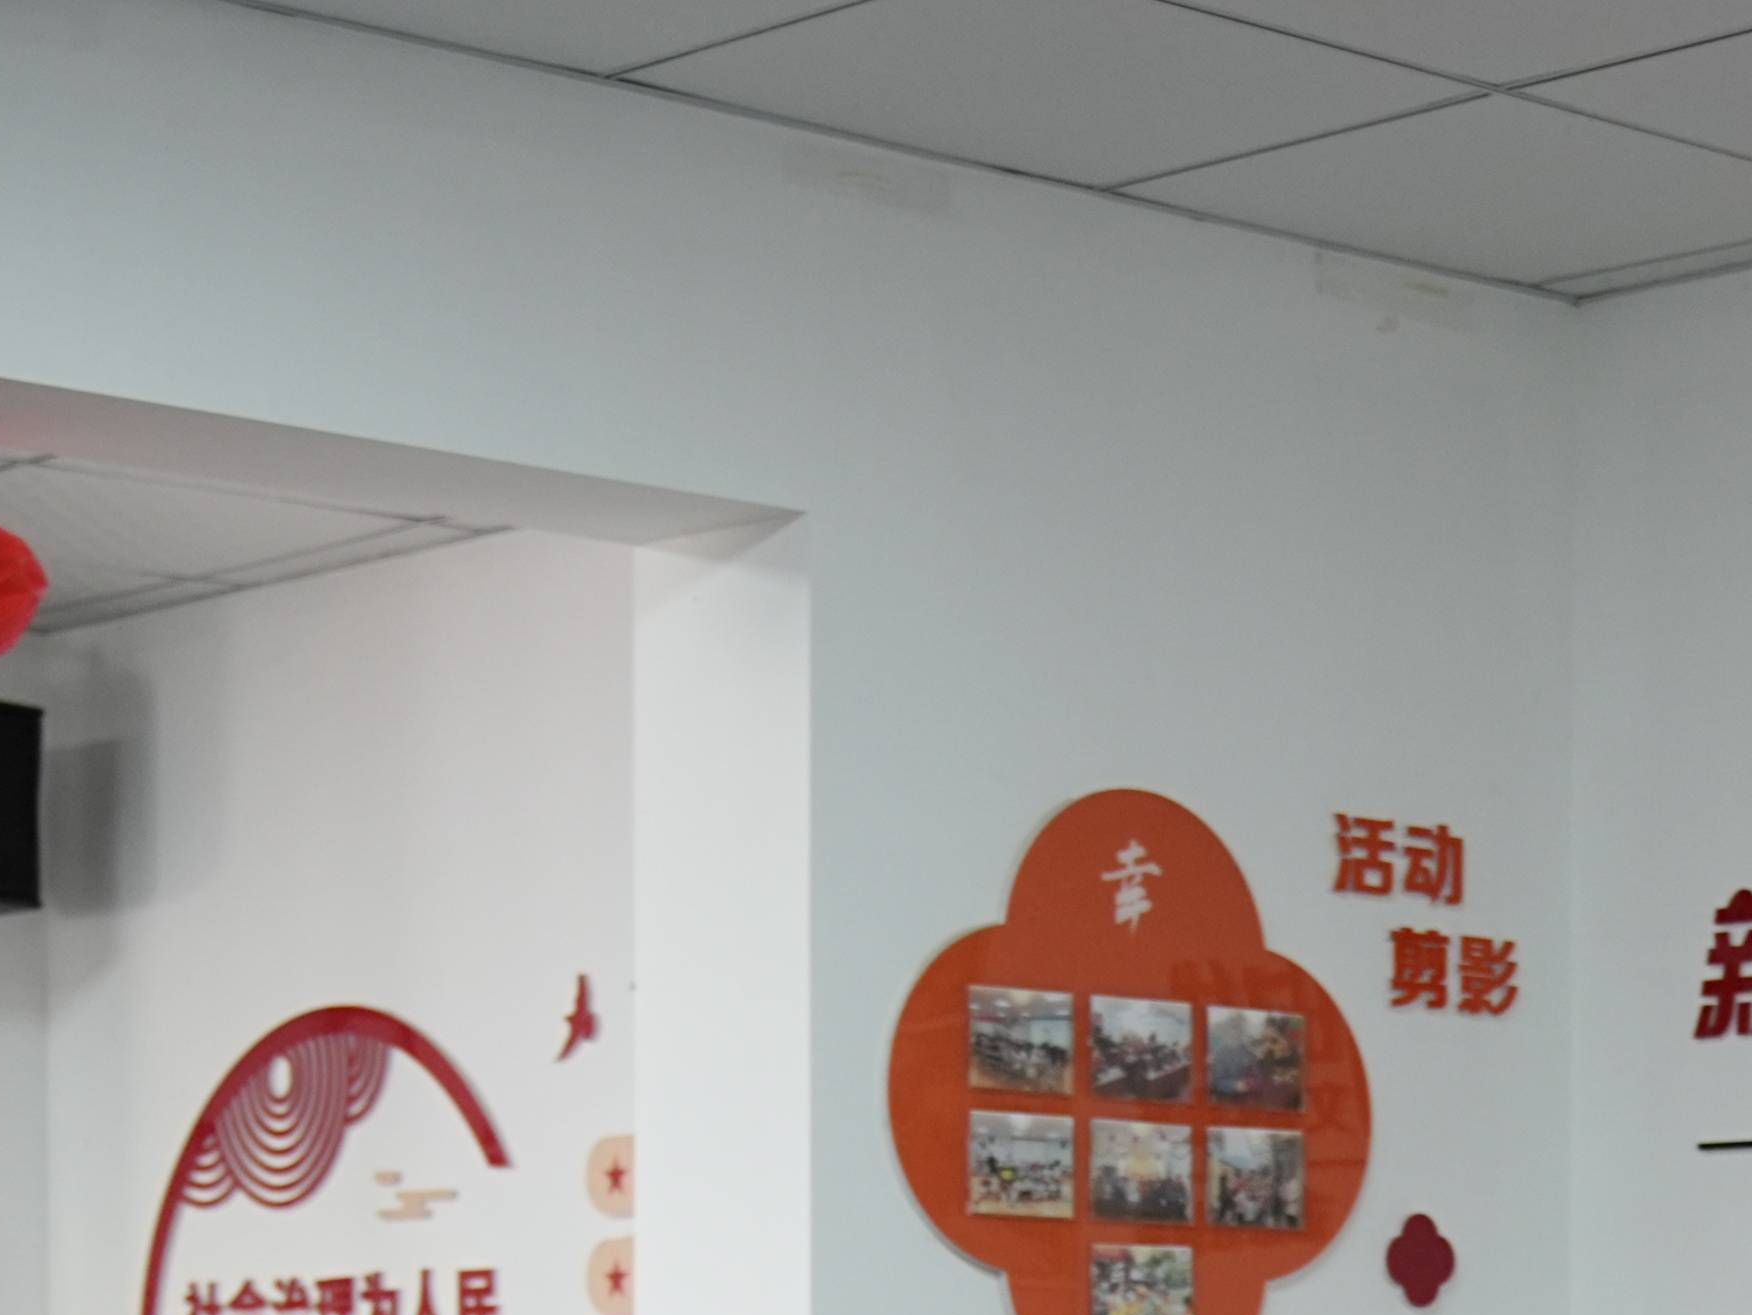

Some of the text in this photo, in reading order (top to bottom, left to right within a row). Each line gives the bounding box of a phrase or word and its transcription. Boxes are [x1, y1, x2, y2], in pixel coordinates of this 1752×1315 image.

[1099, 838, 1162, 934] 幸
[1332, 812, 1465, 906] 活动
[1389, 925, 1519, 1016] 剪影
